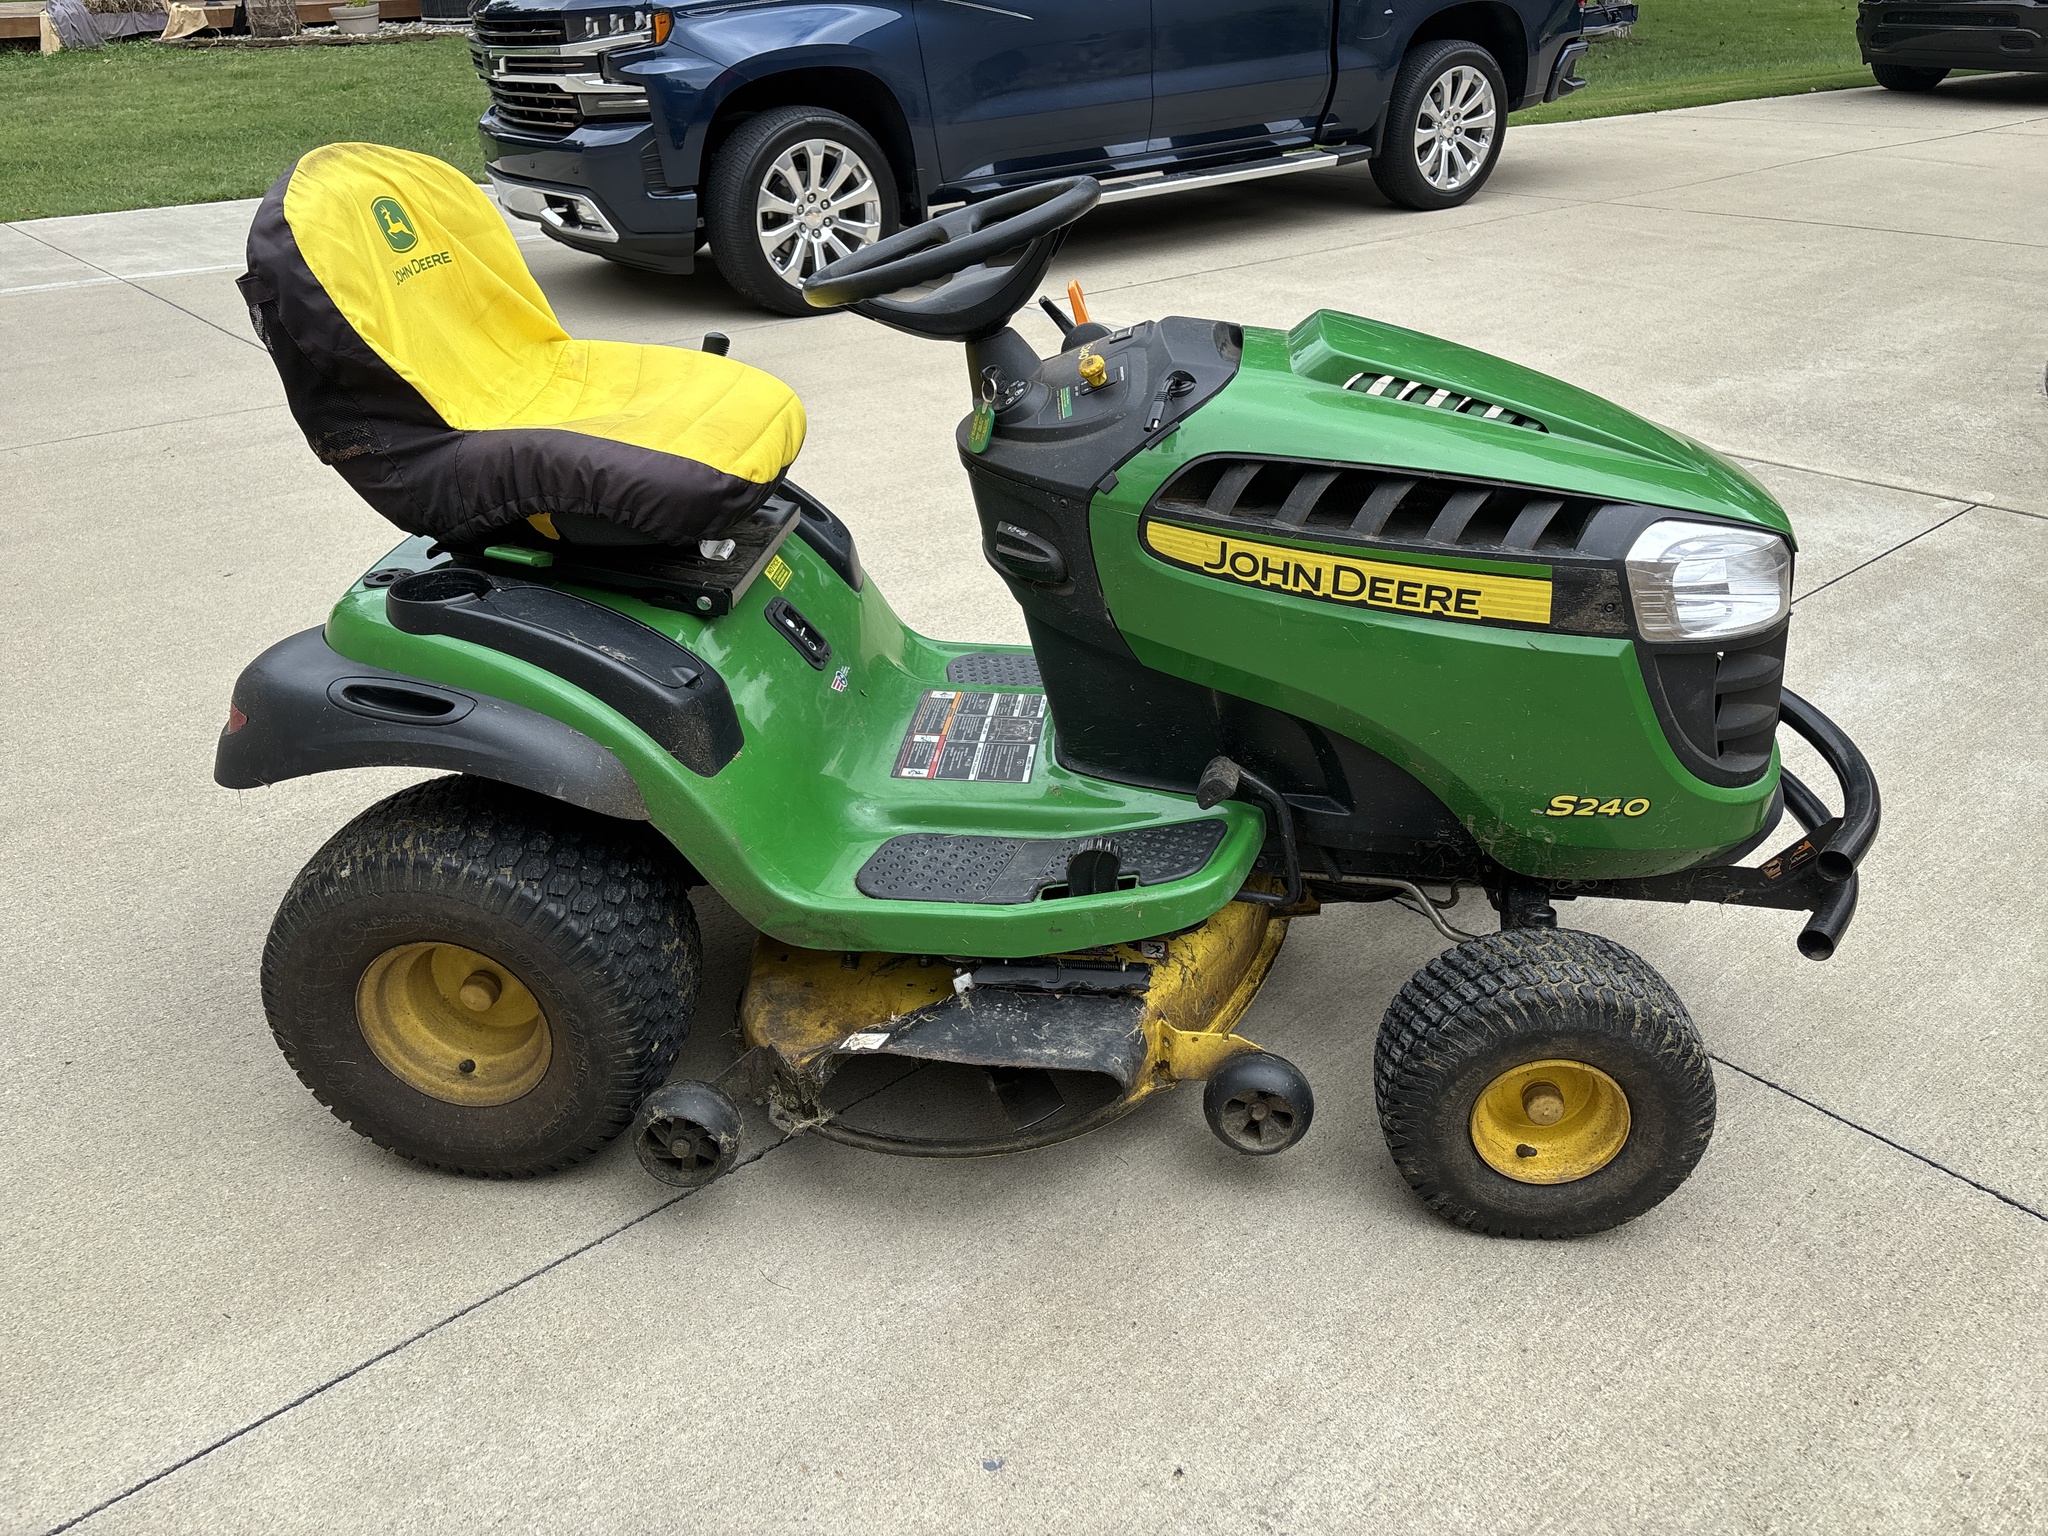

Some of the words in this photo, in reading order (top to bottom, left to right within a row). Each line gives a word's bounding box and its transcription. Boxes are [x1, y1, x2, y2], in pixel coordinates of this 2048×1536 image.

[392, 264, 414, 286] JOHN
[411, 251, 452, 274] DEERE
[766, 556, 781, 576] NOTICE
[1203, 541, 1322, 593] JOHN
[1332, 565, 1481, 615] DEERE
[1545, 794, 1651, 817] S240
